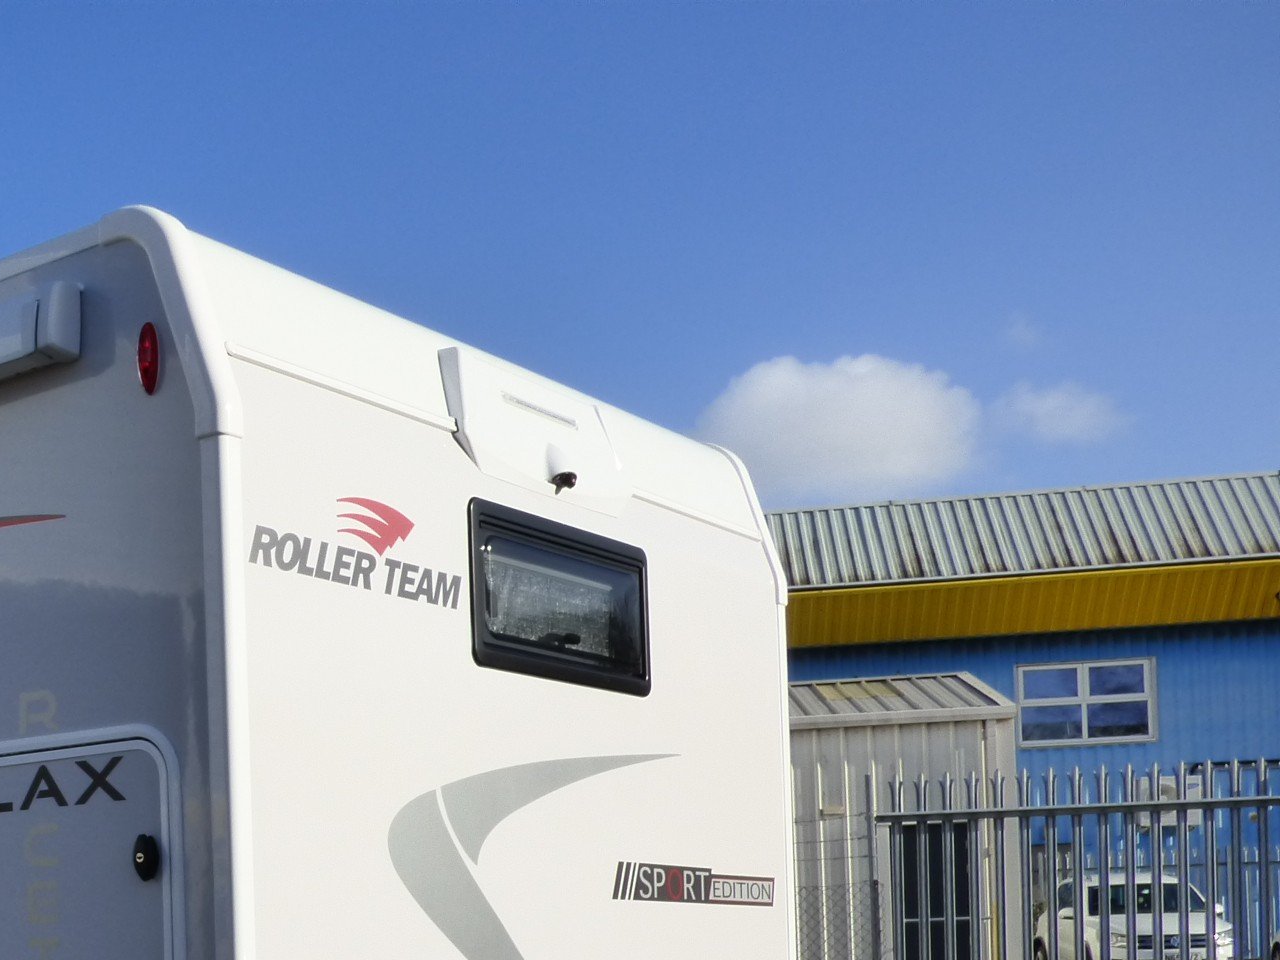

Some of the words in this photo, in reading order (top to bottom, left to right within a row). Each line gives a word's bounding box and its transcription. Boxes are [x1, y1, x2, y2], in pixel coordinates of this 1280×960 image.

[249, 525, 377, 590] ROLLER
[384, 558, 461, 610] TEAM
[639, 866, 710, 902] SPORT
[713, 880, 771, 901] EDITION
